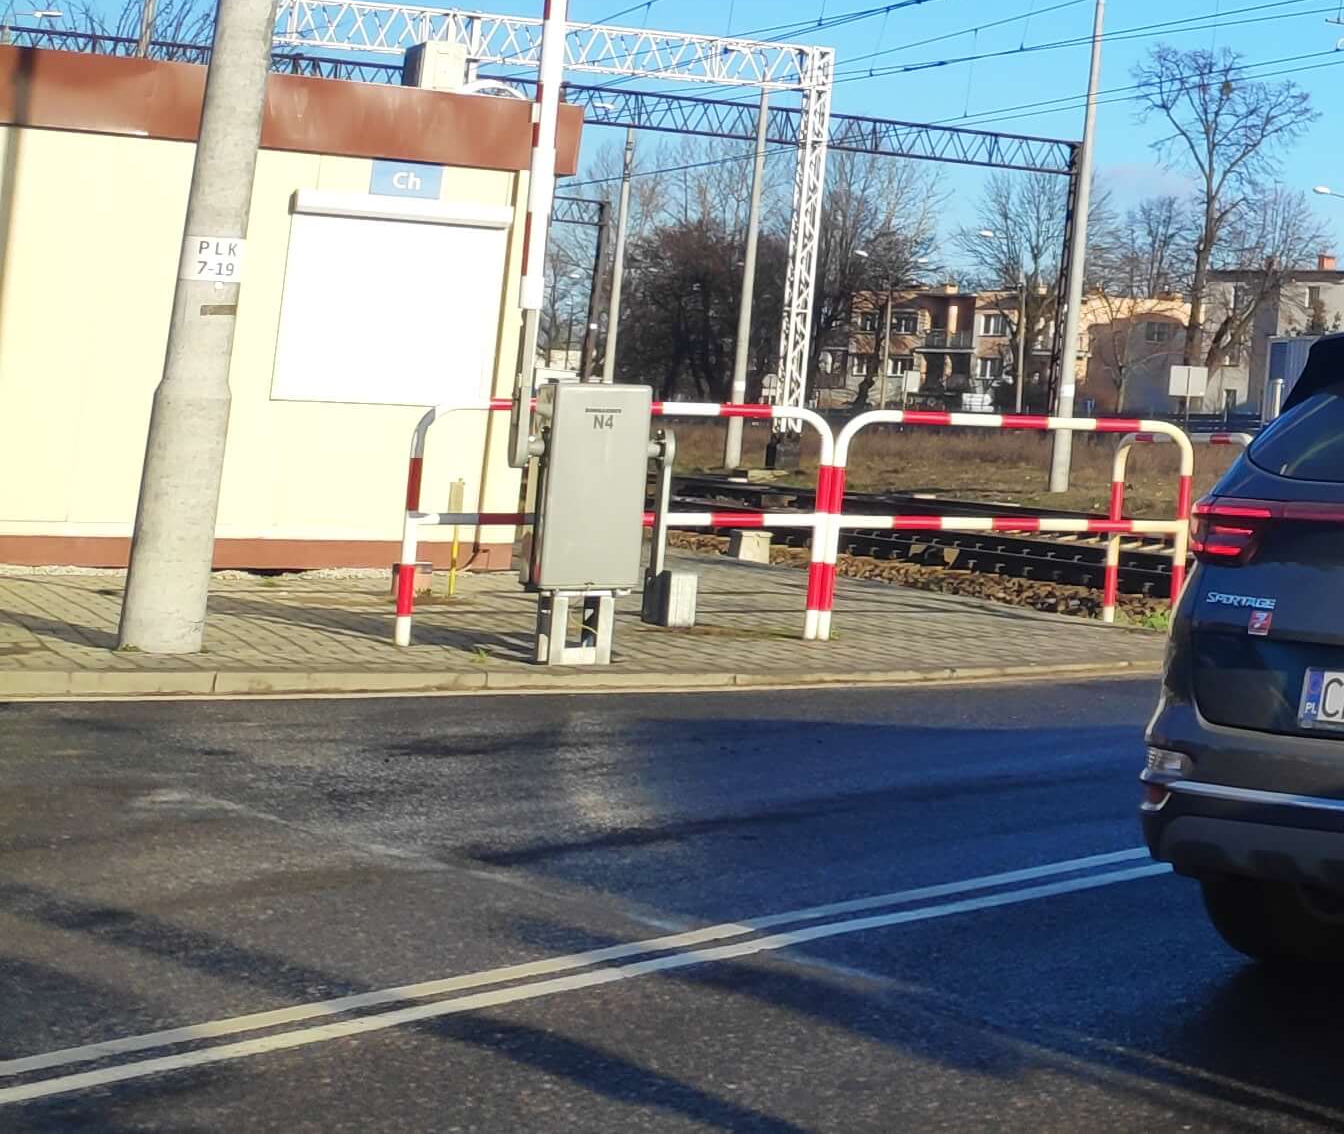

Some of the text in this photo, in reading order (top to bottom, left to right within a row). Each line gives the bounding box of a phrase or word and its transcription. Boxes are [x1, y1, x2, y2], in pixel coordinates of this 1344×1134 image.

[392, 171, 421, 191] Ch
[197, 260, 235, 277] 7-19
[593, 414, 614, 429] N4
[1206, 592, 1277, 609] SPORTAGE
[1305, 702, 1317, 714] PL
